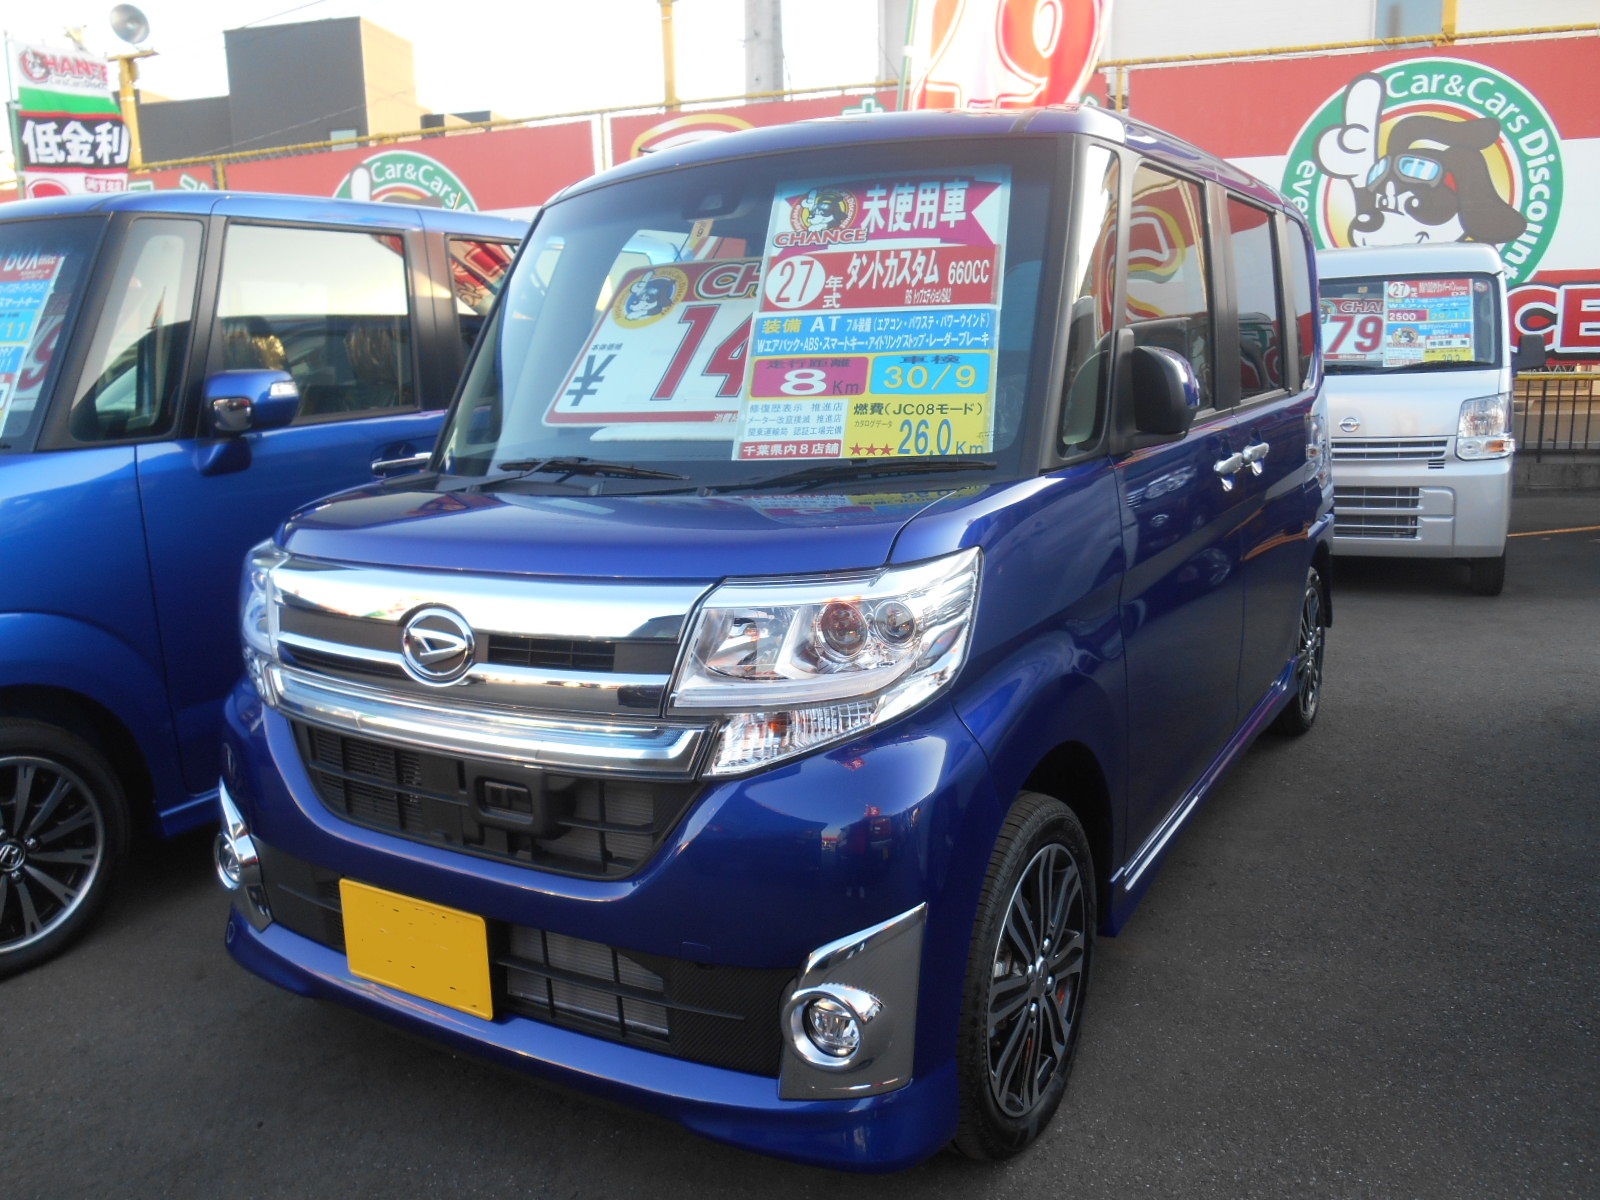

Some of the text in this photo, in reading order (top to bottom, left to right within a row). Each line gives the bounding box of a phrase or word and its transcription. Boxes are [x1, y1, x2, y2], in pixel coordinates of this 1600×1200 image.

[22, 120, 130, 165] 低金利
[860, 182, 969, 233] 未使用車
[1503, 130, 1556, 282] Discount
[774, 229, 867, 247] CHANCE
[775, 258, 816, 303] 27
[822, 275, 843, 309] 年式
[948, 260, 990, 284] 660CC
[1393, 283, 1405, 296] 27
[761, 319, 802, 334] 装備
[810, 316, 841, 332] AT
[1389, 312, 1416, 321] 2500
[1326, 315, 1384, 353] 79
[900, 355, 960, 365] 車検
[780, 368, 859, 395] 8 Km
[884, 364, 977, 390] 30/9
[811, 402, 842, 412] 推進店
[853, 402, 983, 415] 燃費(JC08モード)
[854, 420, 892, 428] カタログデータ
[897, 419, 984, 456] 26.0 Km
[743, 443, 840, 457] 千葉県内8店舗
